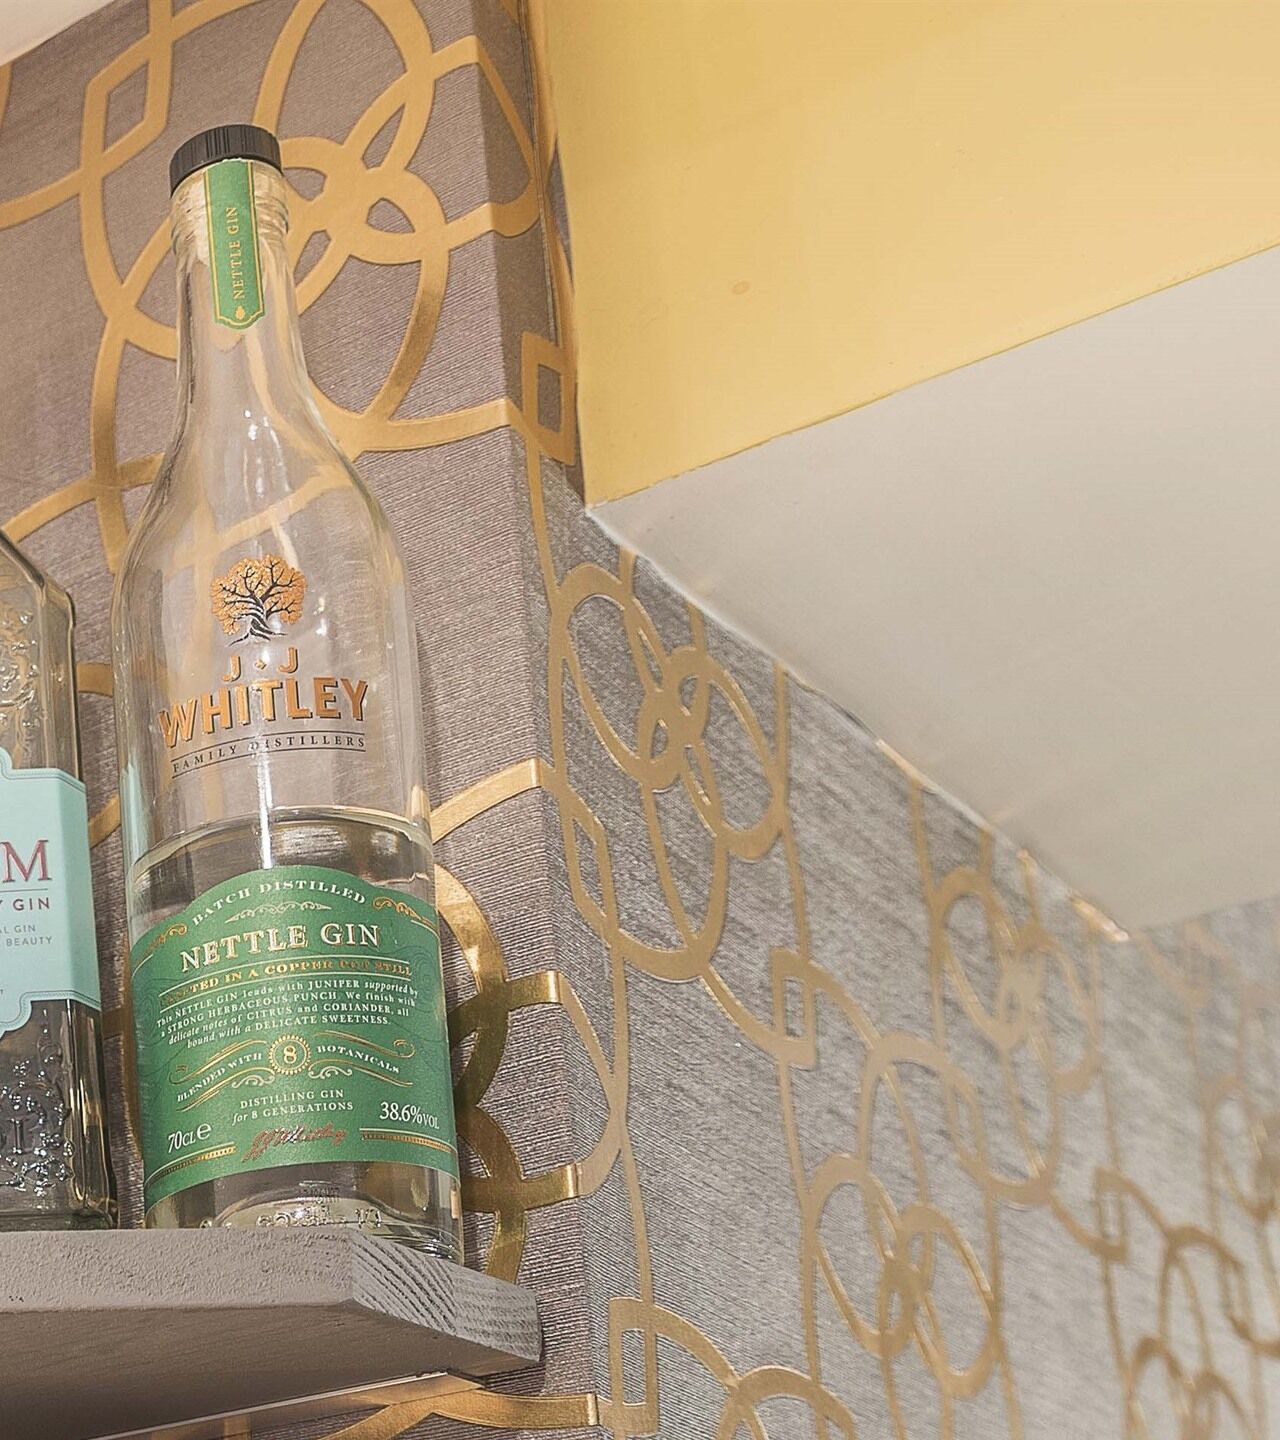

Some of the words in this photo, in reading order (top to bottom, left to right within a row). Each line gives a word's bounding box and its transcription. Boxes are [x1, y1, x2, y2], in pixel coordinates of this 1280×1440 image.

[225, 206, 241, 235] GIN
[228, 240, 246, 300] NETTLE
[158, 676, 369, 749] WHITLEY
[172, 742, 239, 774] FAMILY
[248, 735, 366, 751] DISTILLERS
[12, 897, 51, 912] GIN
[192, 888, 252, 926] BATCH
[259, 879, 368, 905] DISTILLED
[9, 923, 36, 935] GIN
[180, 926, 310, 973] NETTLE
[320, 923, 381, 948] GIN
